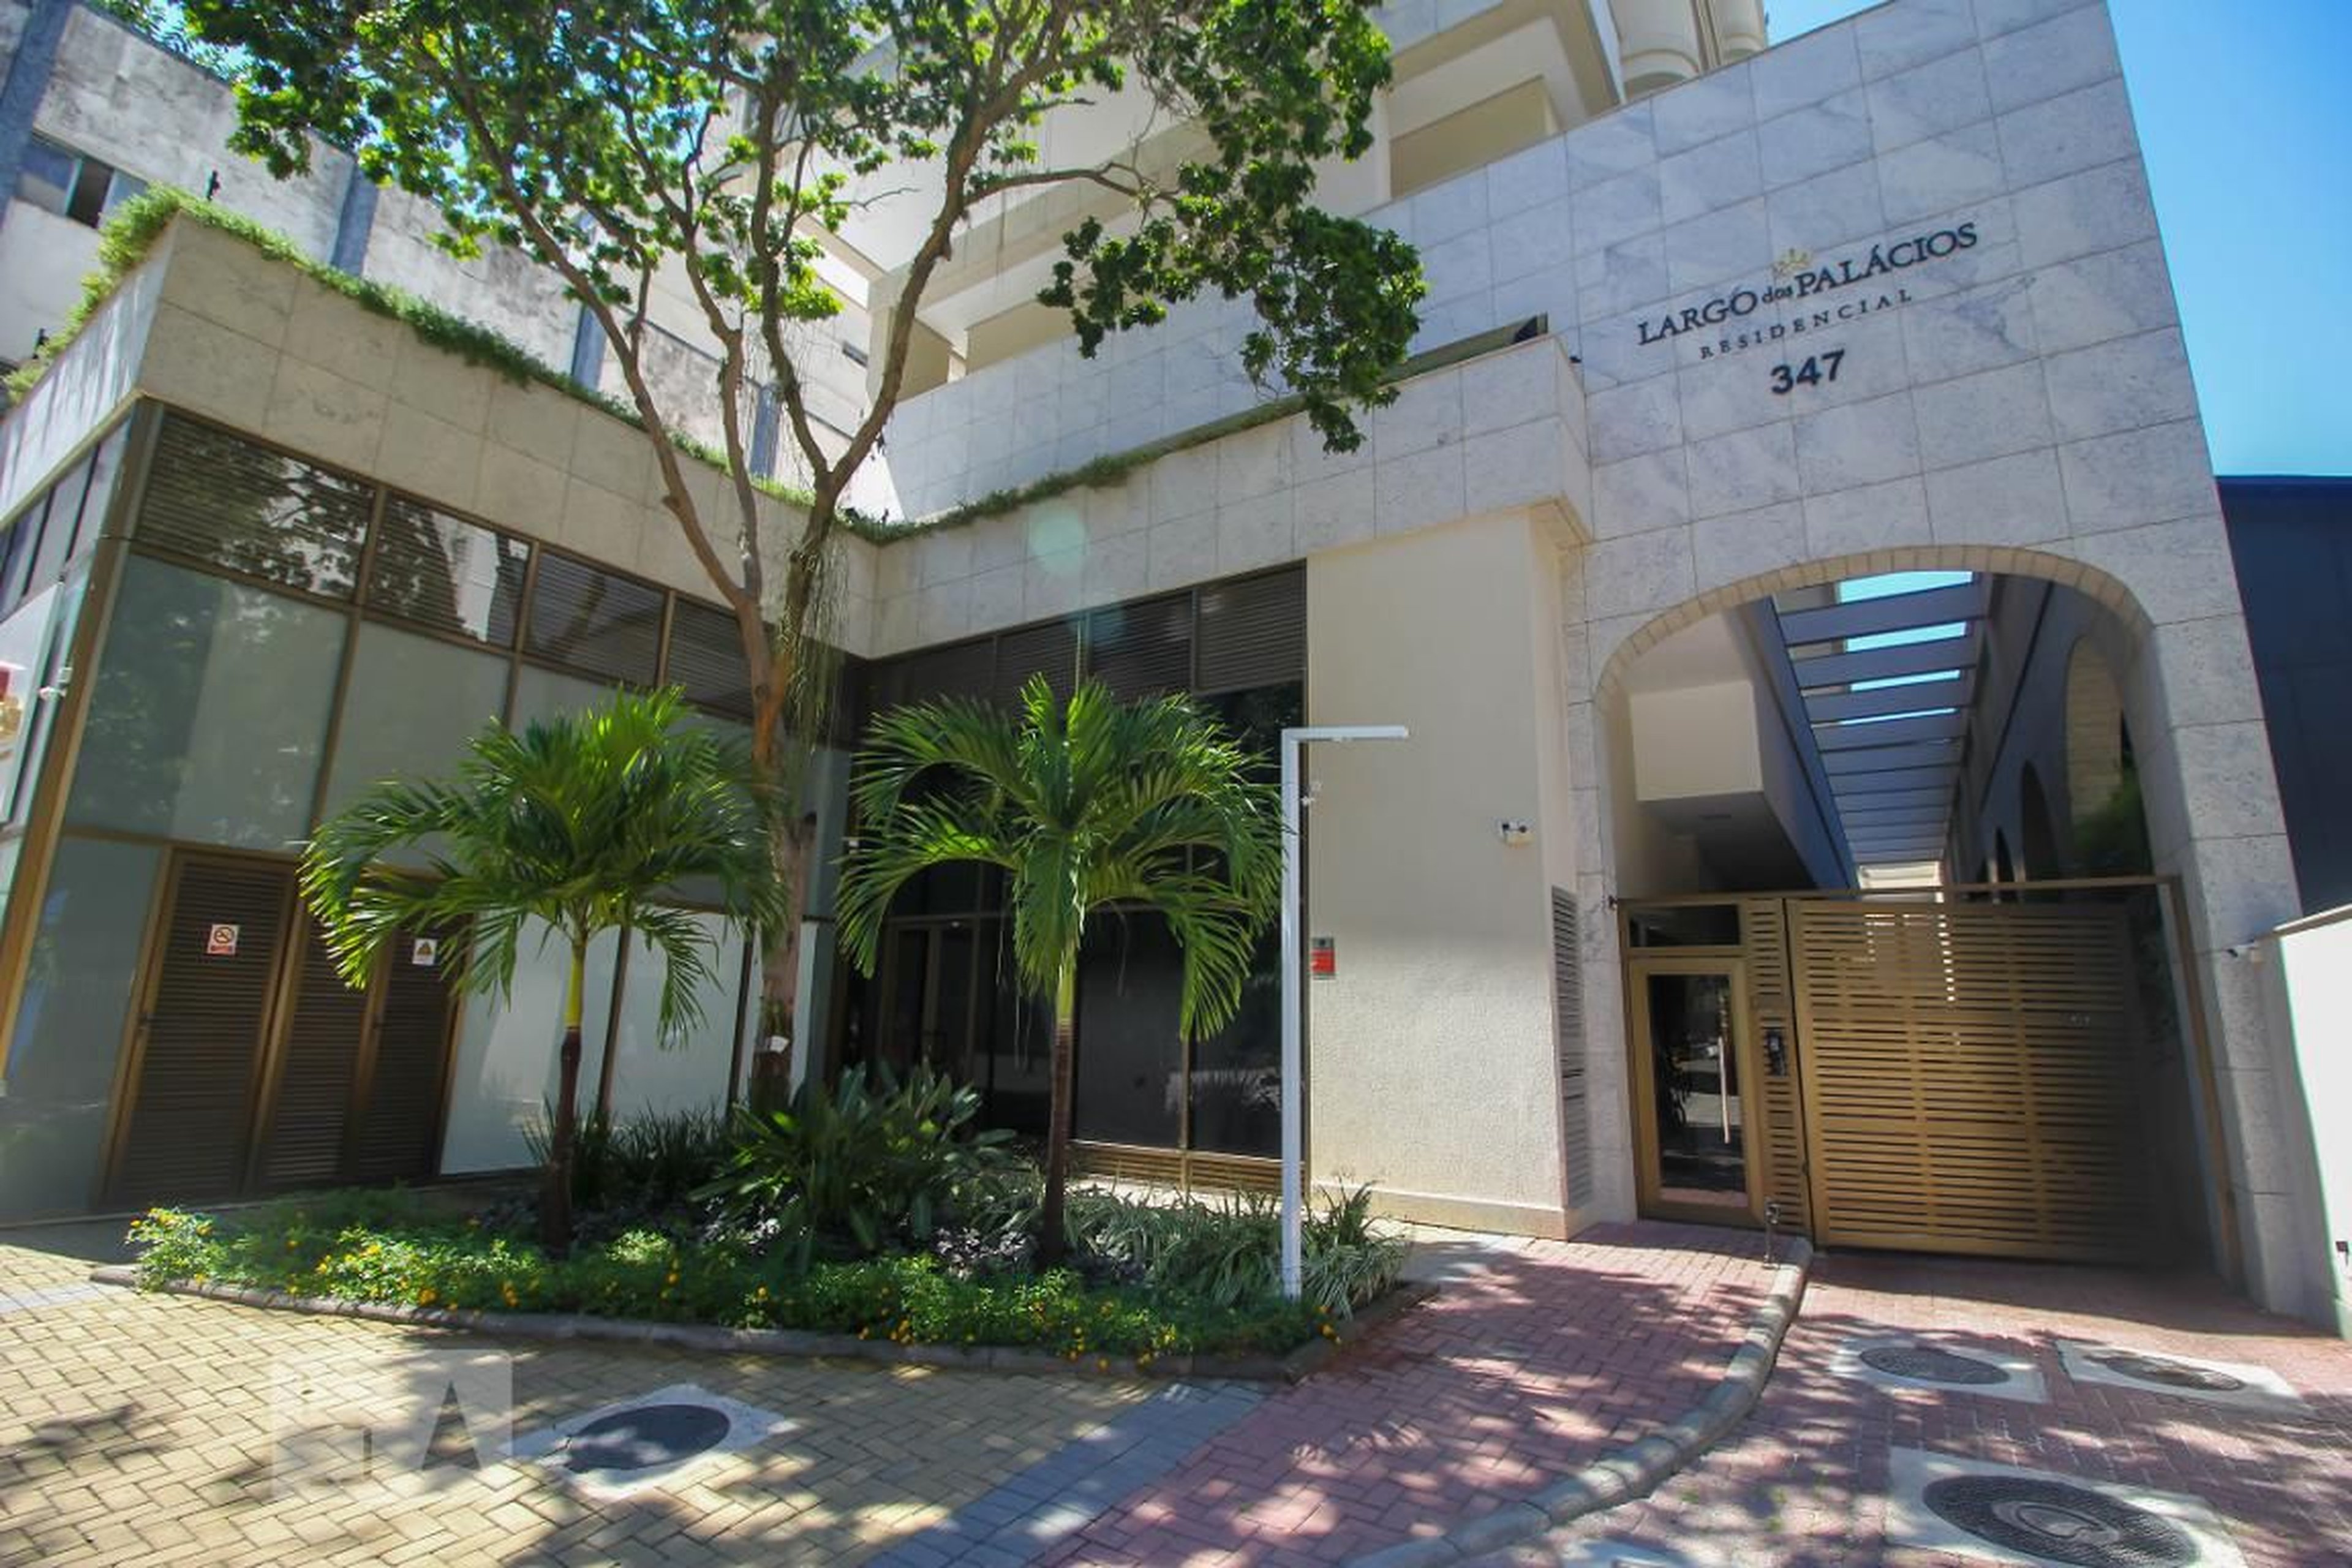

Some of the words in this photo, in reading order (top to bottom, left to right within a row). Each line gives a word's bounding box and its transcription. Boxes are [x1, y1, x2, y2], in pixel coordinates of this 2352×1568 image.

[1638, 290, 1757, 345] LARGO
[1762, 285, 1793, 304] dos
[1795, 222, 1978, 297] PALÁCIOS
[1700, 290, 1912, 360] RESIDENCIAL
[1770, 349, 1845, 395] 347
